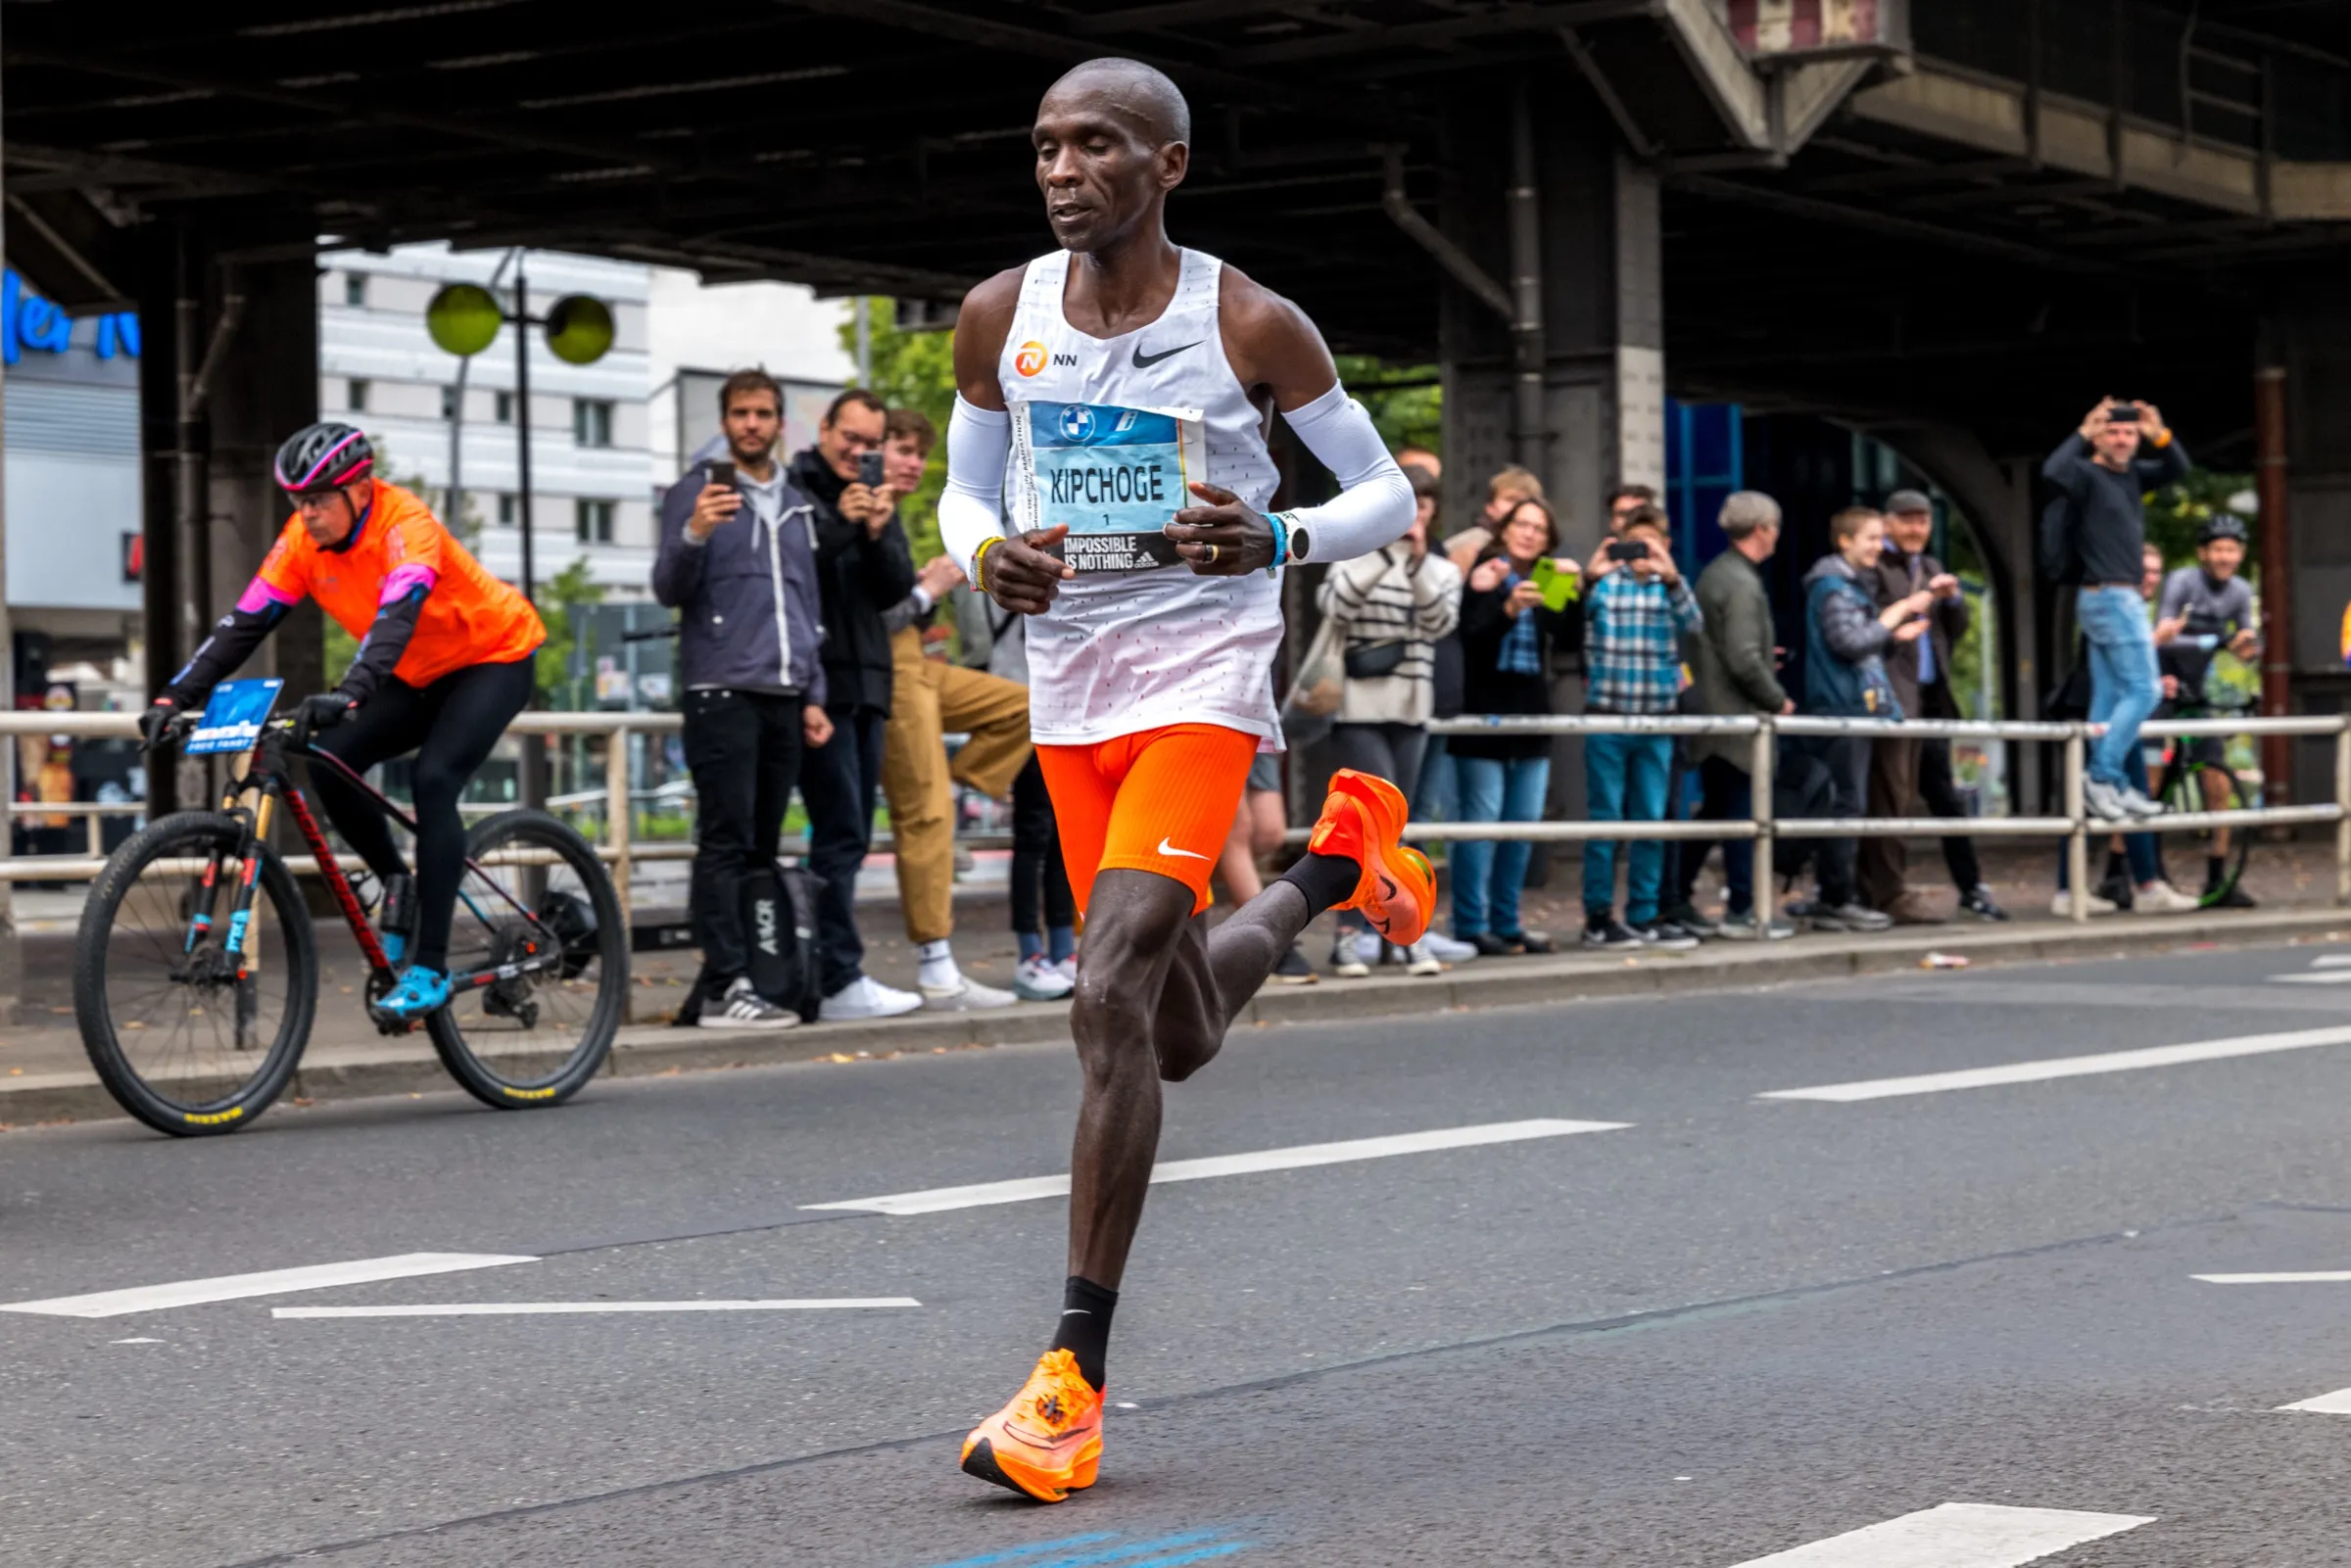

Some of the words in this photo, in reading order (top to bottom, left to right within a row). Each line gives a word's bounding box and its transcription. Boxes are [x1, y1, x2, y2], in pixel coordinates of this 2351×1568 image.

[1052, 354, 1078, 367] NN
[1050, 465, 1164, 503] KIPCHOGE
[1102, 513, 1110, 526] 1
[1063, 536, 1137, 553] IMPOSSIBLE
[1065, 554, 1078, 570] IS
[1079, 552, 1134, 570] NOTHING
